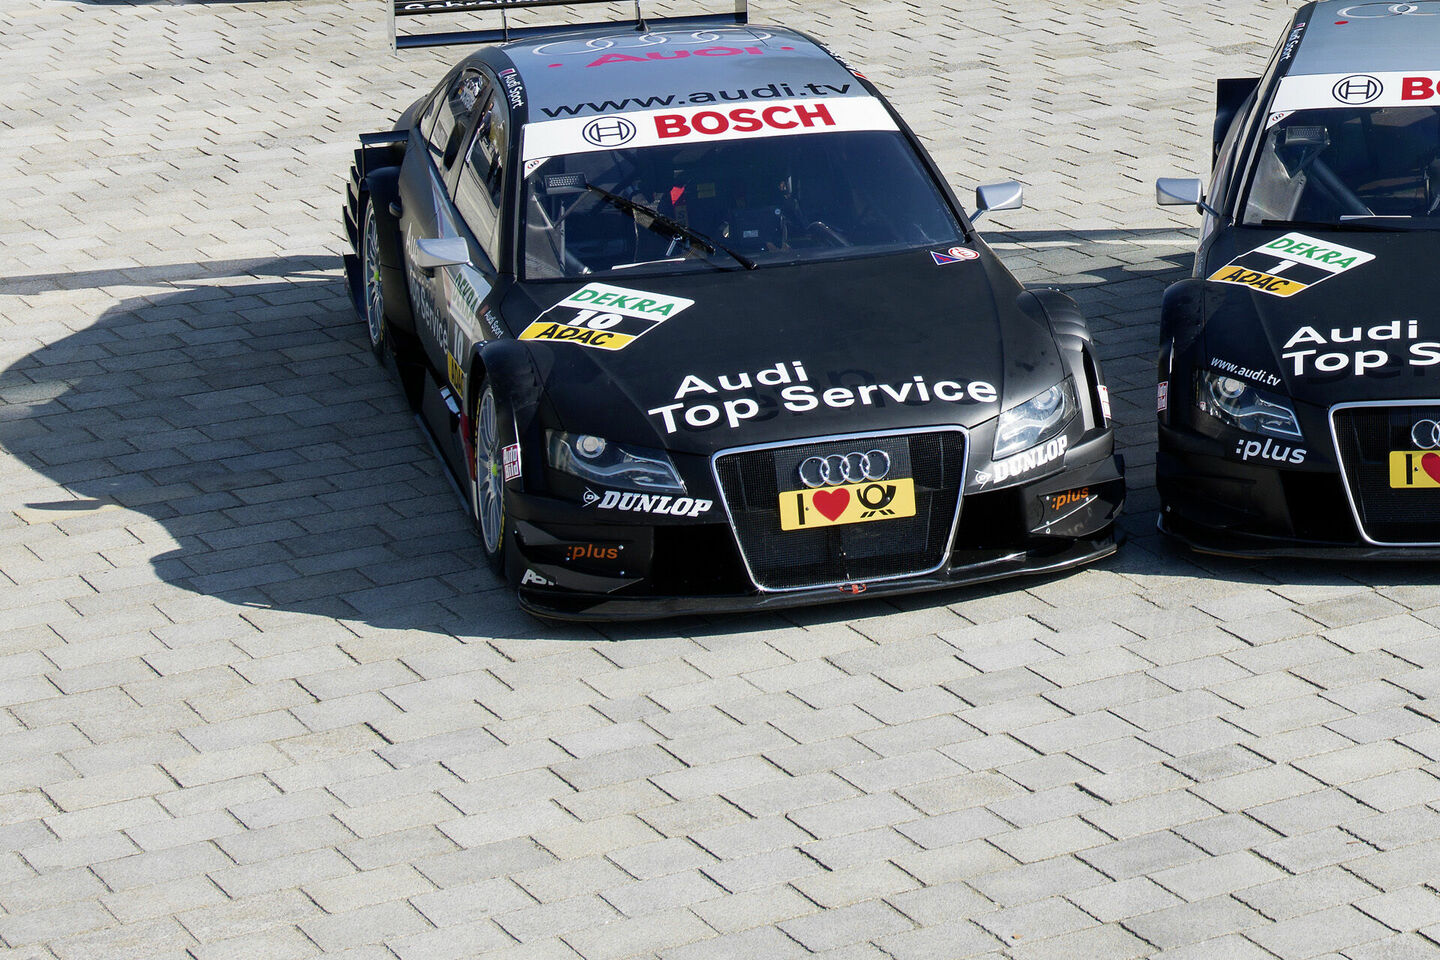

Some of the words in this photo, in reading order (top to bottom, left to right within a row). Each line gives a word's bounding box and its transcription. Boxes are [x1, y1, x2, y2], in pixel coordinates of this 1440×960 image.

[586, 45, 765, 68] Audi
[540, 81, 852, 118] www.audi.tv
[653, 103, 836, 139] BOSCH
[1265, 237, 1358, 270] DEKRA
[1266, 259, 1298, 275] 1
[1222, 267, 1291, 293] ADAC
[567, 288, 677, 317] DEKRA
[565, 307, 624, 330] 10
[1285, 319, 1418, 347] Audi
[533, 322, 615, 348] ADAC
[1210, 356, 1281, 387] www.audi.tv
[1281, 347, 1388, 376] Top
[673, 360, 809, 400] Audi
[648, 398, 759, 435] Top
[782, 374, 999, 414] Service
[993, 435, 1068, 484] DUNLOP
[598, 490, 713, 518] DUNLOP
